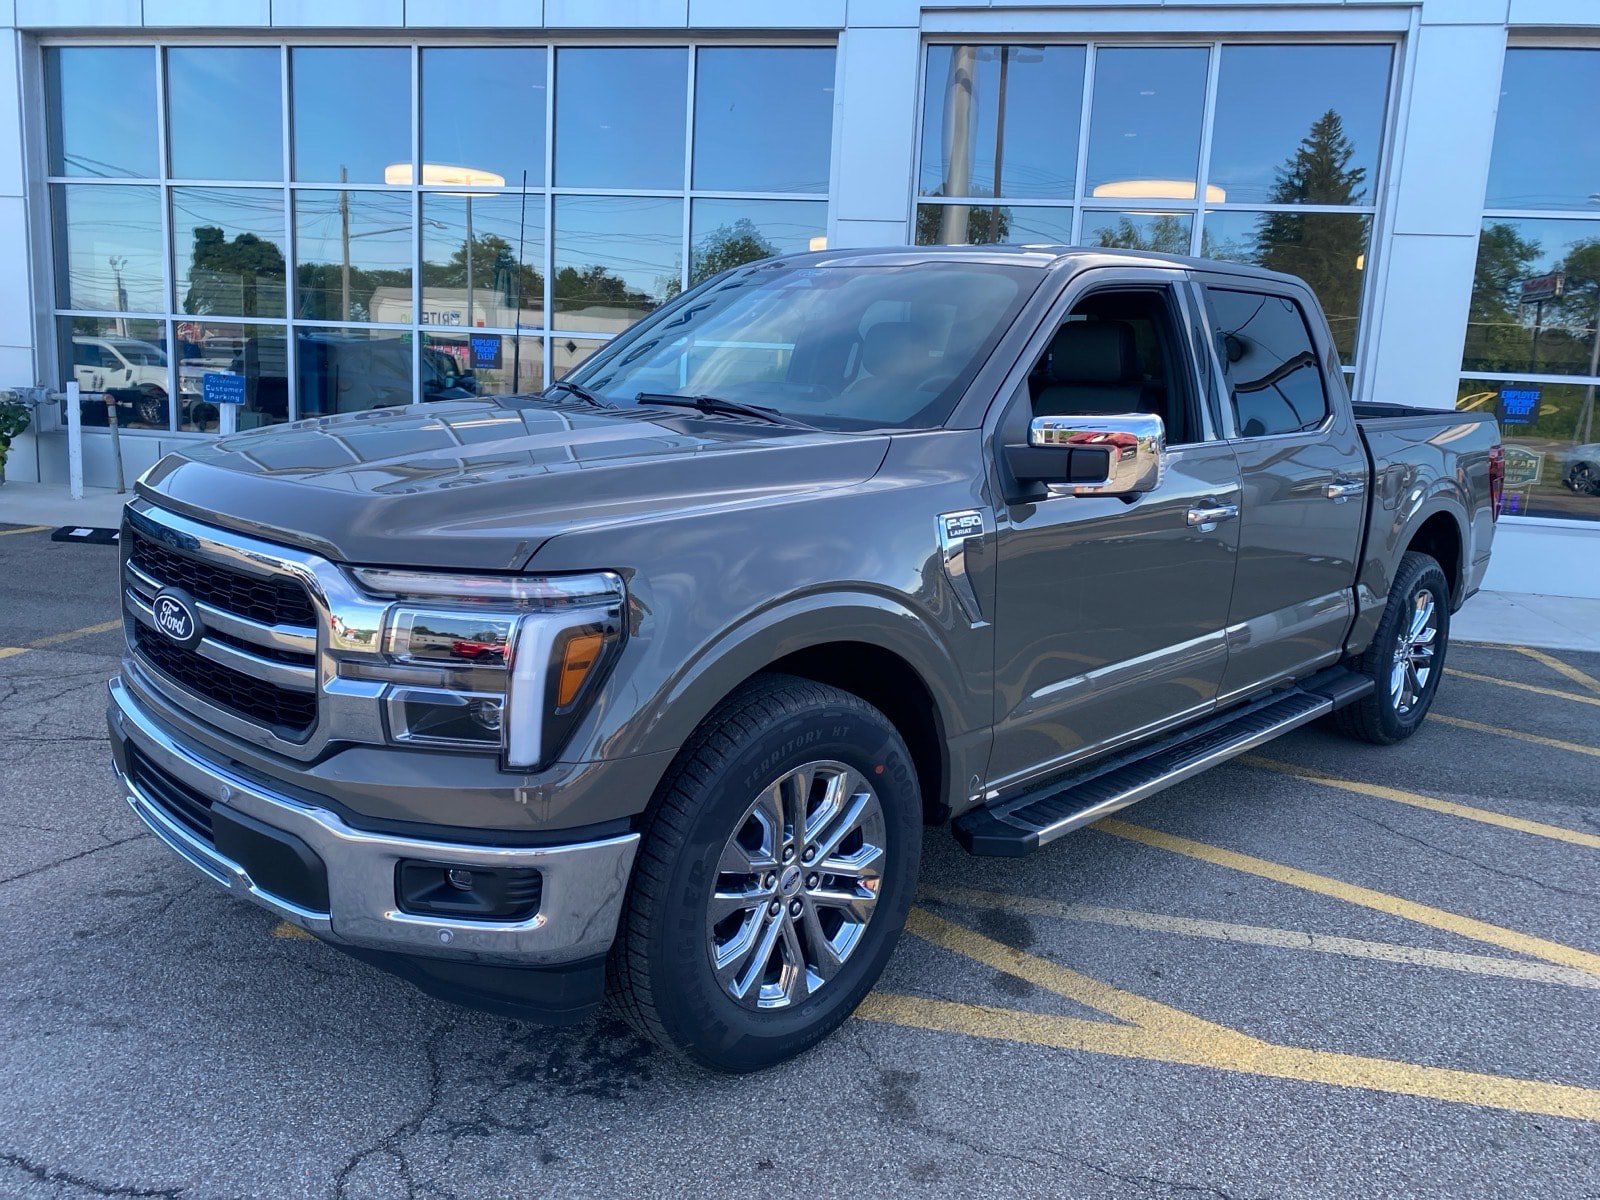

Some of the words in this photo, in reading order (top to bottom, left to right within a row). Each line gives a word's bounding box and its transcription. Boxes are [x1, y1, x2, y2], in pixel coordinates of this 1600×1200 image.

[471, 338, 501, 347] EMPLOYEE
[477, 353, 495, 361] EVENT
[205, 384, 244, 394] Customer
[209, 393, 240, 402] Parking
[1501, 390, 1541, 399] EMPLOYEE
[1503, 398, 1536, 407] PRICING
[1507, 406, 1531, 415] EVENT
[946, 515, 982, 530] F-150
[950, 528, 972, 537] LARIAT
[159, 600, 186, 636] Ford
[743, 728, 823, 788] TERRITORY
[832, 726, 850, 737] HT
